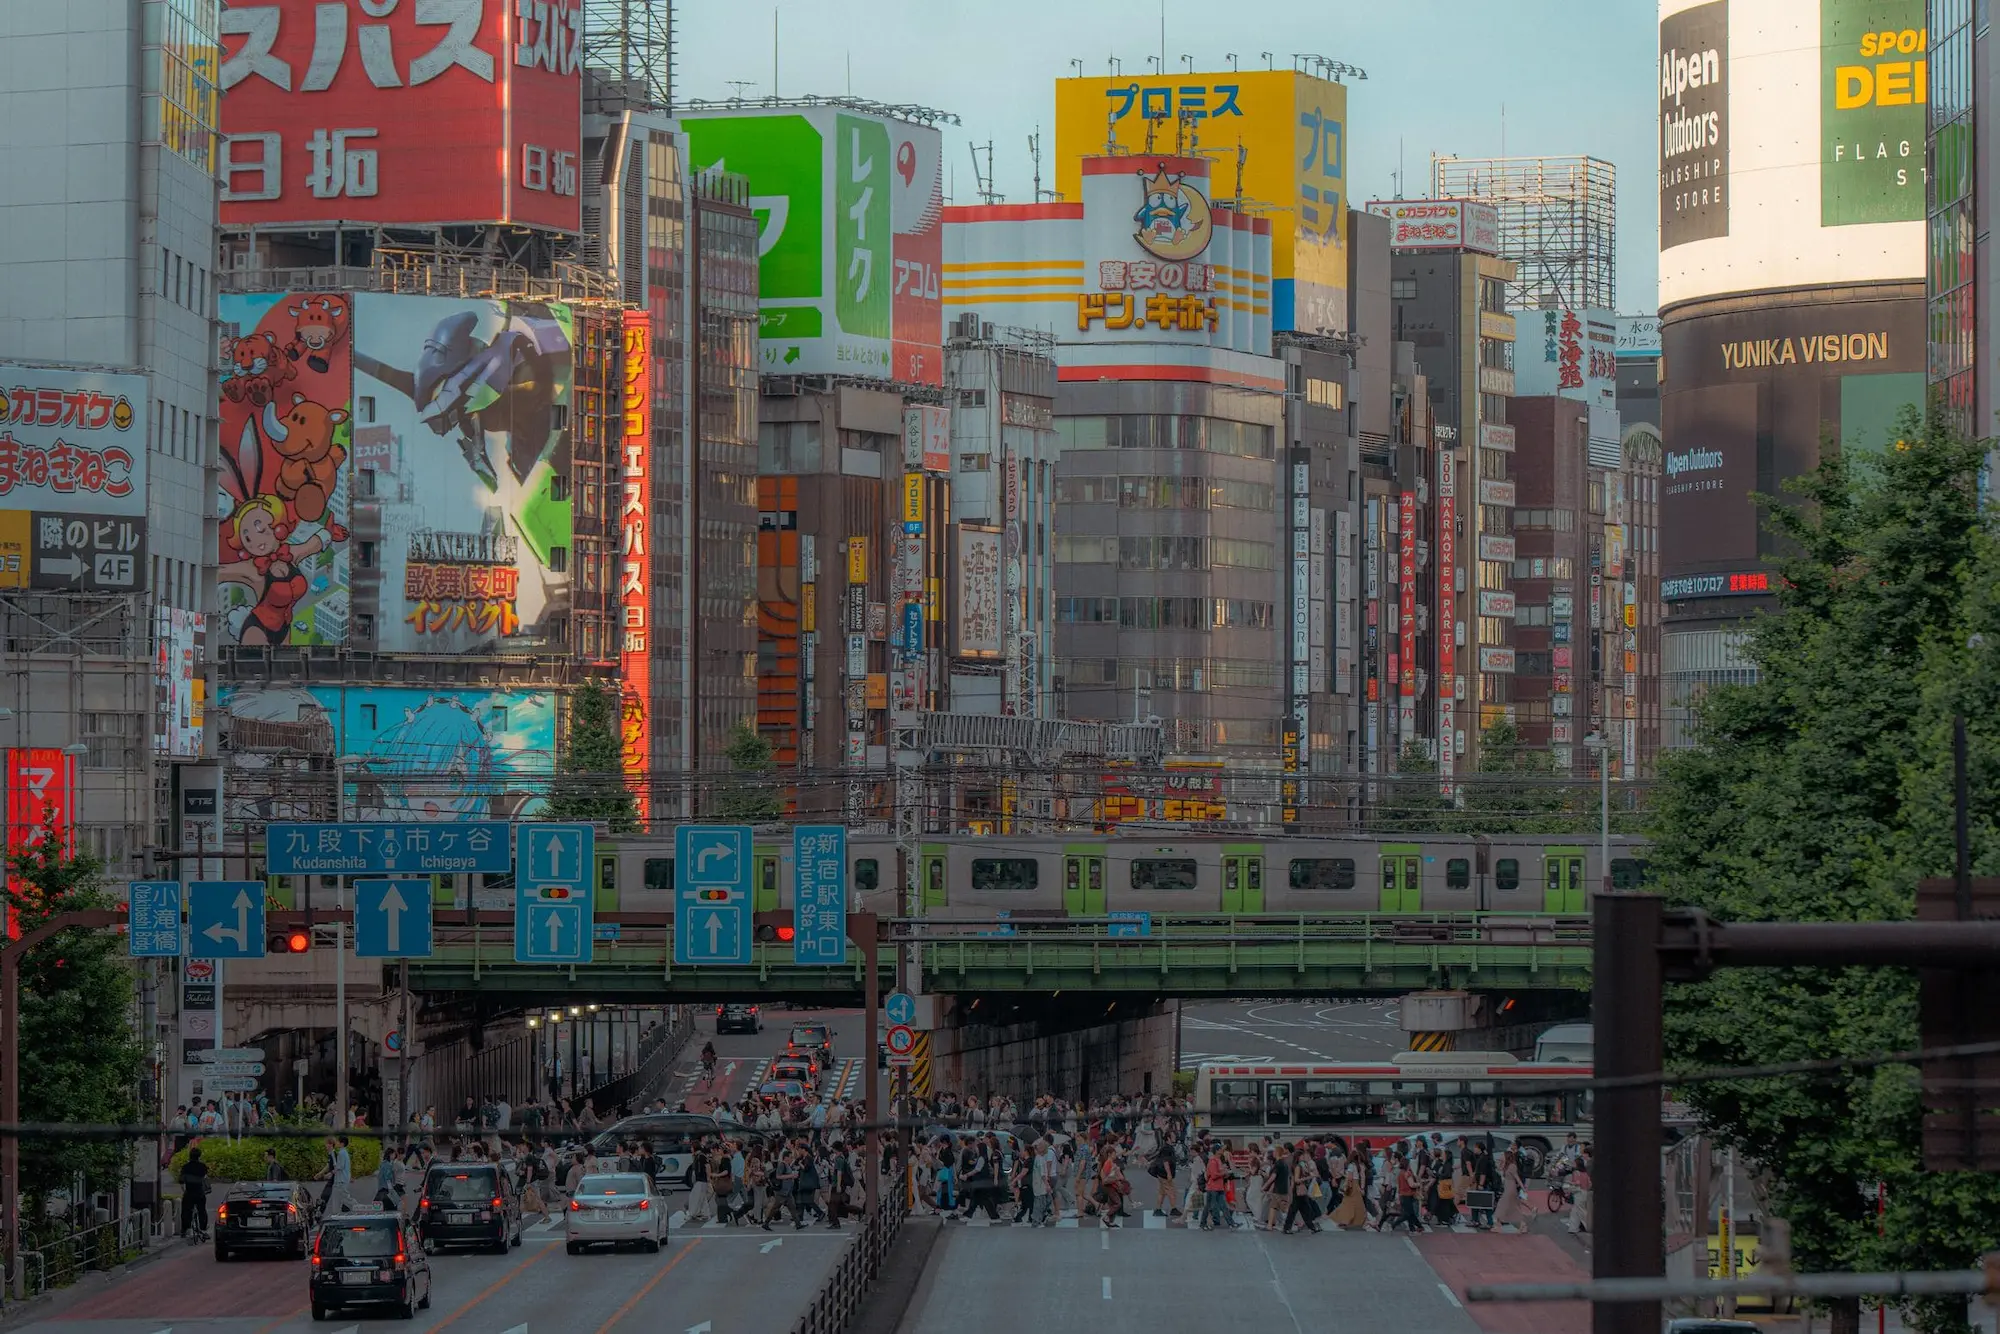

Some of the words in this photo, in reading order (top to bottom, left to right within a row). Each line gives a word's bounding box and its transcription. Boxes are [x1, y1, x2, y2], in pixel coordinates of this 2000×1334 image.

[1859, 28, 1926, 58] SPO
[1661, 48, 1719, 106] Alpen
[1105, 83, 1244, 119] プロミス
[1664, 106, 1719, 160] Outdoors
[1835, 140, 1926, 162] FLAG
[219, 127, 379, 201] 日拓
[521, 143, 576, 196] 日拓
[1661, 158, 1721, 190] FLAGSHIP
[848, 126, 874, 303] レイク
[1404, 206, 1449, 218] カラオケ
[1675, 186, 1721, 211] STORE
[1396, 223, 1457, 242] まねきねこ
[894, 257, 939, 300] アコム
[1557, 310, 1584, 389] 東海苑
[1618, 335, 1662, 348] クリニッ
[1721, 337, 1796, 370] YUNIKA
[1799, 331, 1888, 364] VISION
[624, 327, 646, 437] パチンコ
[908, 353, 924, 377] 8F
[9, 386, 114, 428] カラオケ
[908, 413, 919, 459] 戸谷ビル
[0, 433, 134, 497] まねきねこ
[1666, 450, 1689, 479] Alpen
[1689, 447, 1723, 471] Outdoors
[909, 478, 920, 518] プロミス
[1695, 479, 1724, 492] STORE
[39, 517, 140, 552] 隣のビル
[624, 445, 645, 597] エスパス
[908, 523, 920, 532] 6F
[1443, 498, 1452, 577] KARAOKE
[407, 533, 519, 562] EVANGELION
[99, 559, 130, 581] 4F
[406, 564, 519, 600] 歌舞伎町
[1443, 583, 1452, 592] &
[1729, 573, 1768, 592] 営業時間
[405, 600, 519, 636] インパクト
[622, 605, 645, 653] 日拓
[1443, 600, 1452, 654] PARTY
[850, 719, 864, 729] 7F
[1443, 704, 1452, 795] PASELA
[286, 828, 374, 853] 九段下
[384, 842, 394, 855] 4
[292, 856, 367, 869] Kudanshita
[420, 856, 476, 869] Ichigaya
[800, 836, 816, 900] Shinjuku
[134, 884, 152, 929] Otakibashi
[816, 833, 839, 957] 新宿駅東口
[152, 886, 177, 952] 小滝橋
